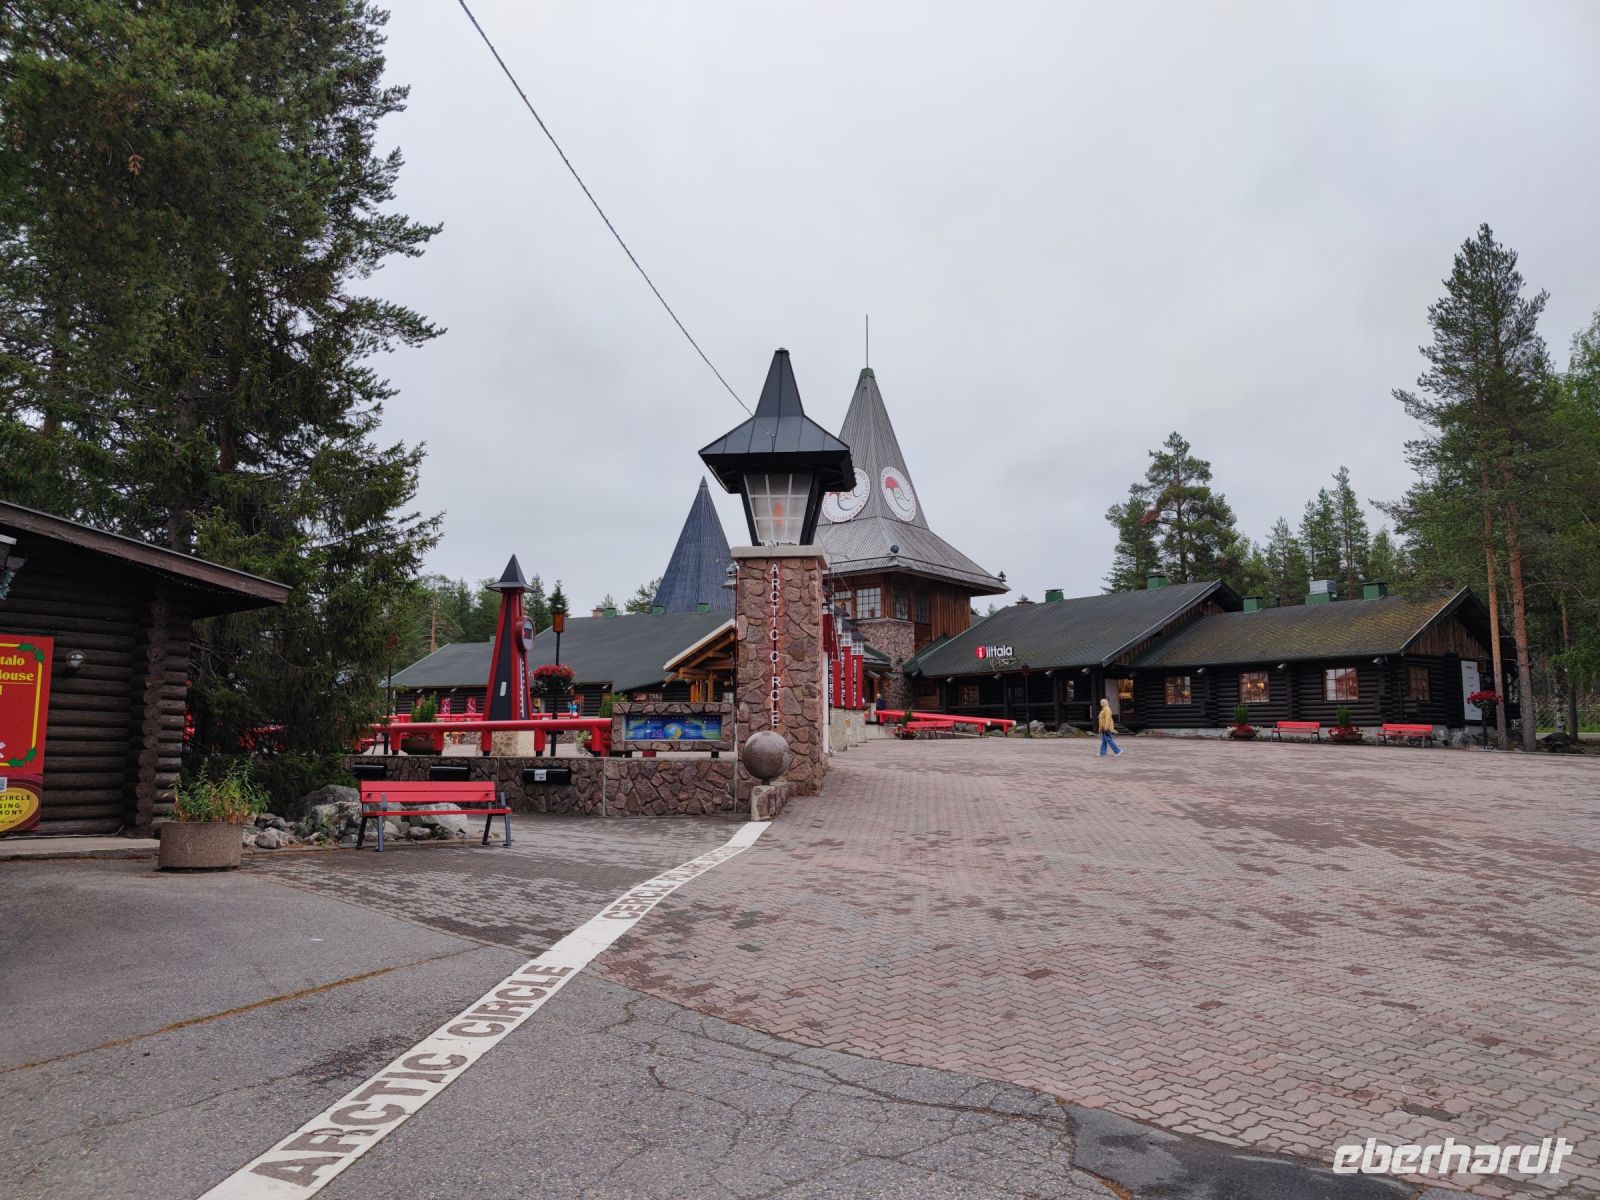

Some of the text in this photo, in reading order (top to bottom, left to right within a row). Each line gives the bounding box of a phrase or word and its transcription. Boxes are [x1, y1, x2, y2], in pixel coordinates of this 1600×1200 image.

[769, 563, 781, 726] ARCTIC CIRCLE
[602, 883, 675, 920] CERCLE
[249, 964, 576, 1187] ARCTIC CIRCLE
